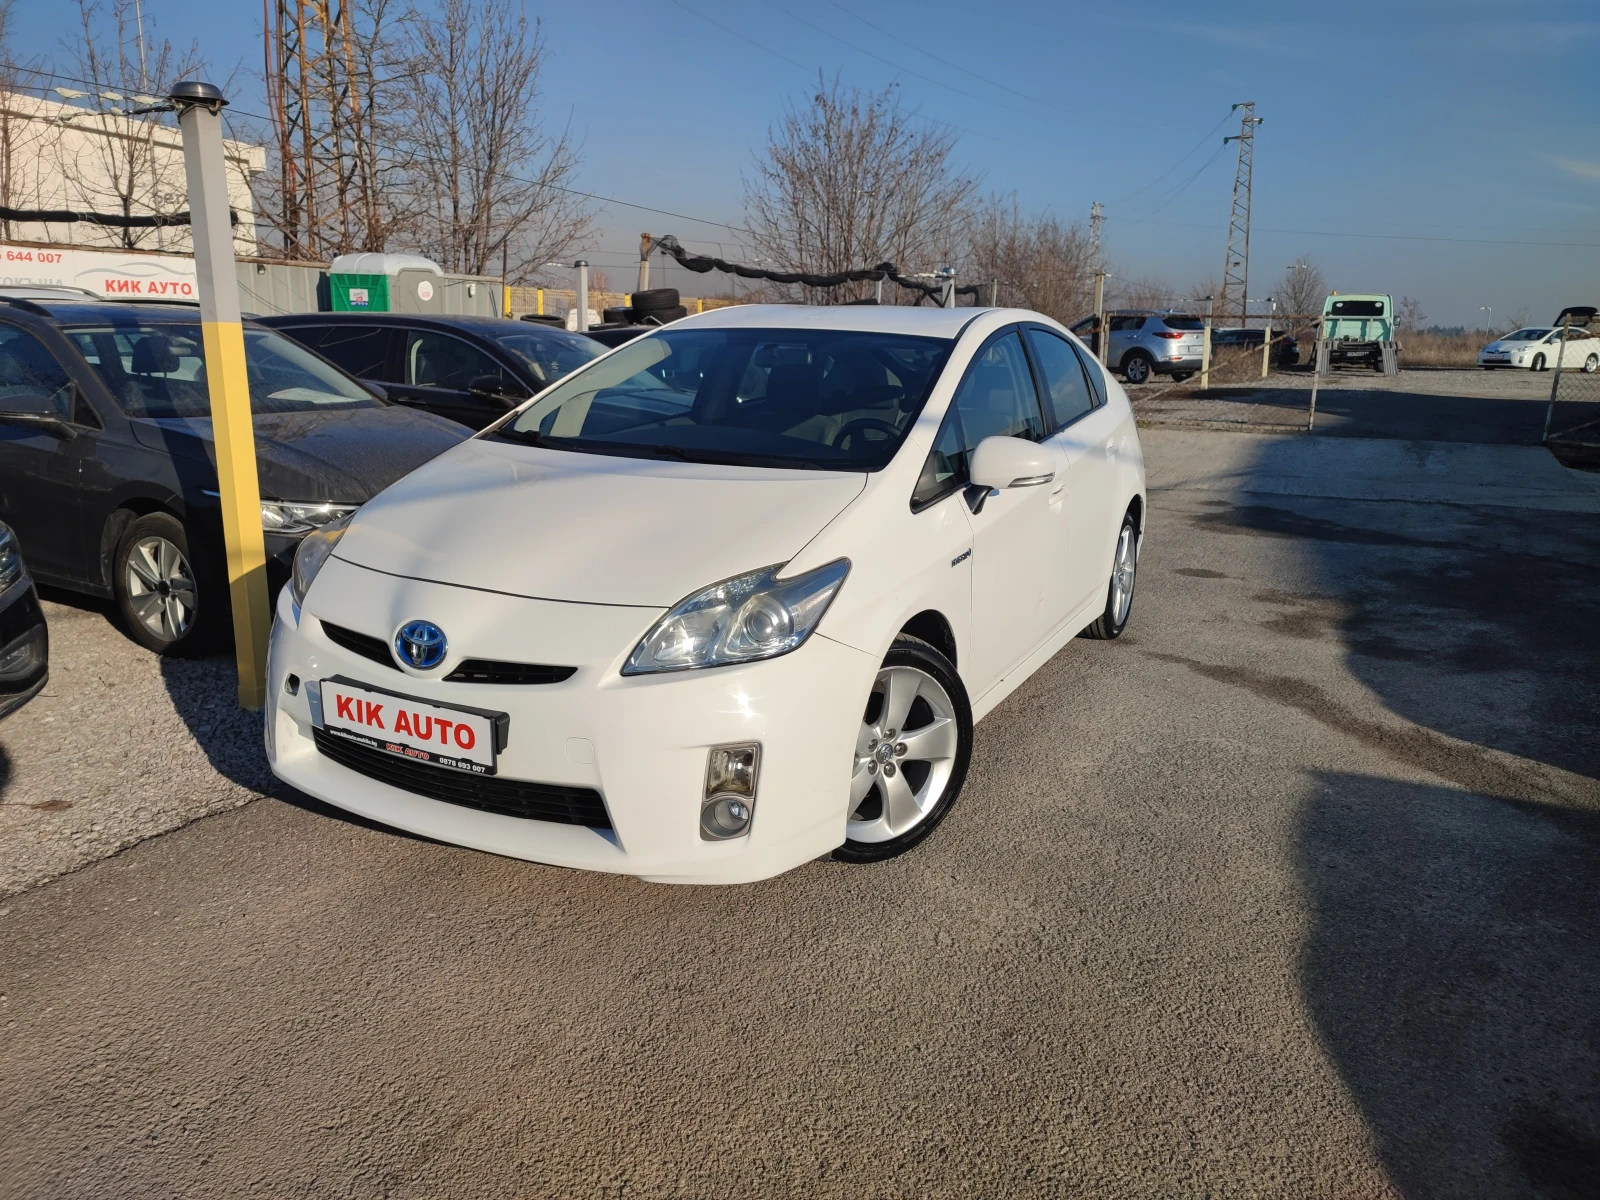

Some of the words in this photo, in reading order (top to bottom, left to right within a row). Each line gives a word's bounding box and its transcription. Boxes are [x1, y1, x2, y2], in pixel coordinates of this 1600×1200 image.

[6, 250, 33, 262] 644
[37, 252, 62, 264] 007
[105, 279, 141, 293] КИК
[147, 281, 192, 296] АУТО
[336, 694, 386, 730] KIK
[394, 709, 476, 750] AUTO
[385, 742, 404, 754] KIK
[404, 747, 430, 760] AUTO
[439, 757, 457, 767] 0878
[472, 765, 486, 773] 007
